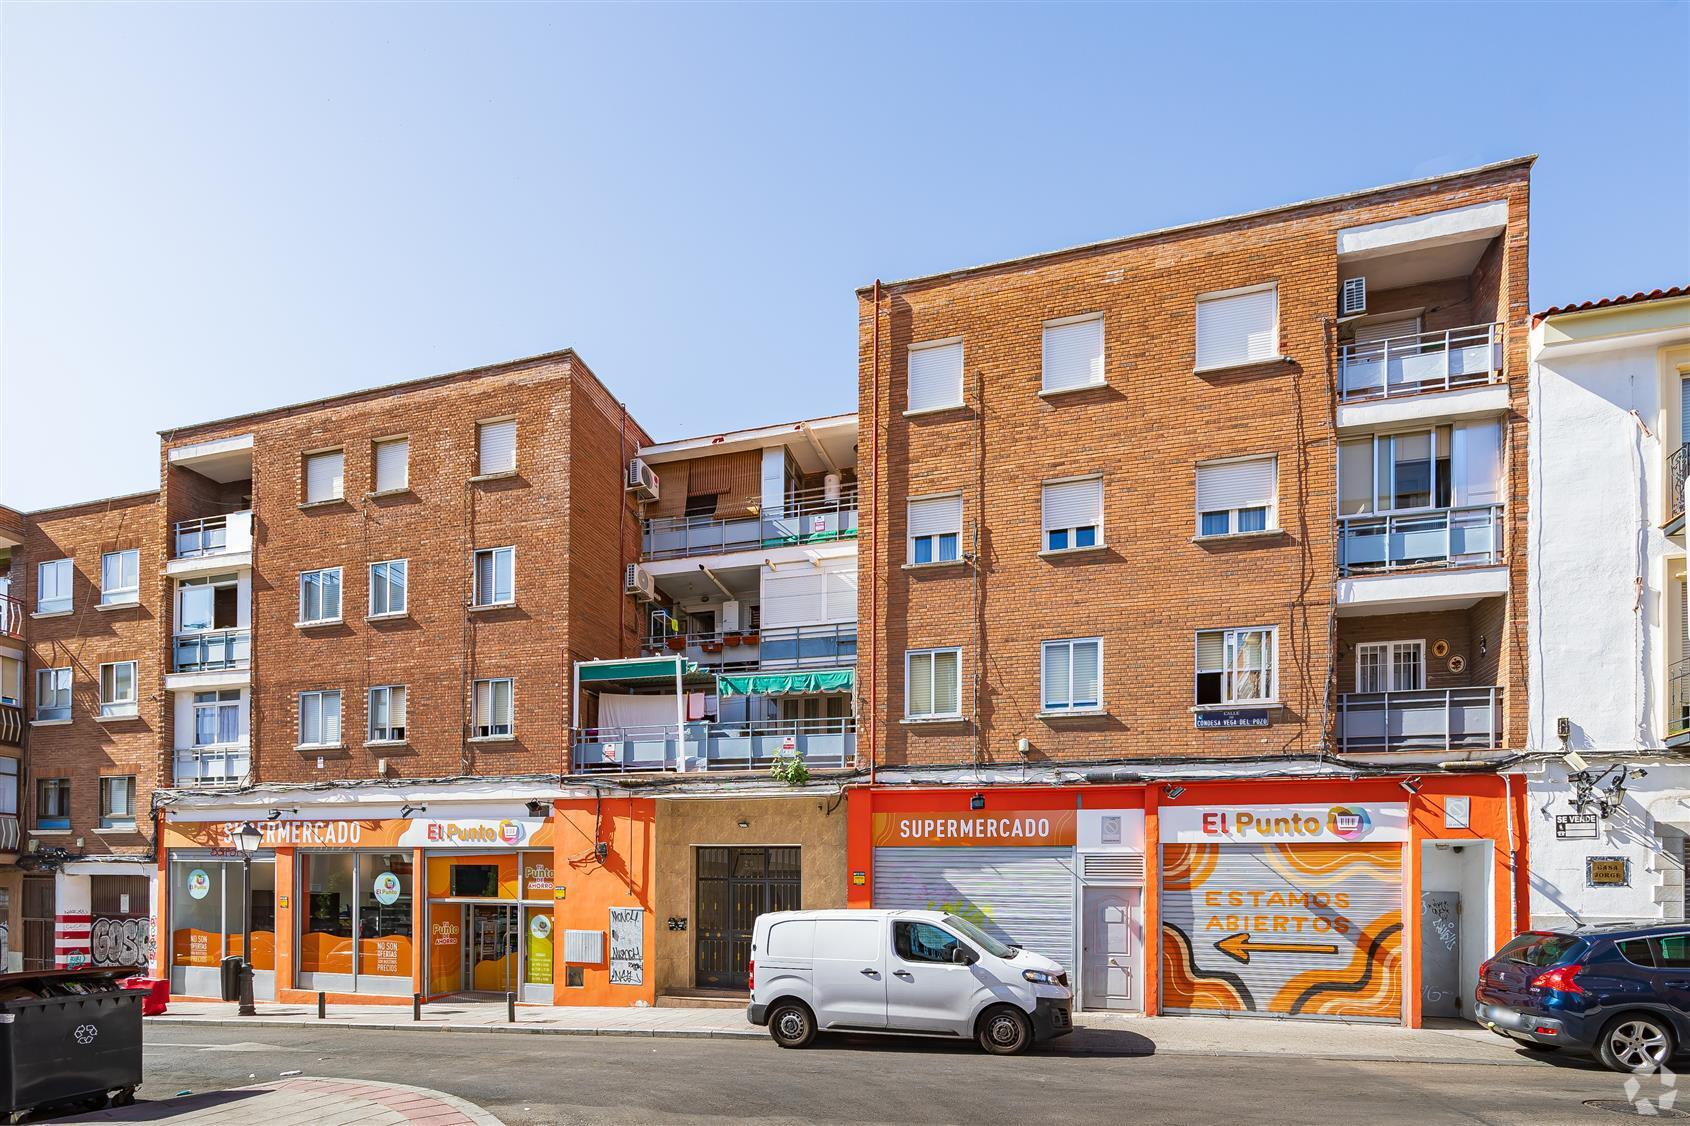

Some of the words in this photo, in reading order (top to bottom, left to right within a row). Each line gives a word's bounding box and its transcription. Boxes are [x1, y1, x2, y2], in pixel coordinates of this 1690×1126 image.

[1197, 719, 1221, 727] CONDESA
[223, 821, 361, 843] SERMERCADO
[427, 823, 444, 840] El
[446, 823, 497, 841] Punto
[900, 818, 1050, 838] SUPERMERCADO
[1202, 812, 1230, 834] El
[1235, 812, 1321, 835] Punto
[1204, 891, 1350, 908] ESTAMOS
[1205, 915, 1350, 933] ABIERTOS
[377, 942, 385, 951] NO
[386, 942, 398, 951] SON
[377, 950, 398, 958] OFERTAS
[377, 964, 398, 972] PRECIOS
